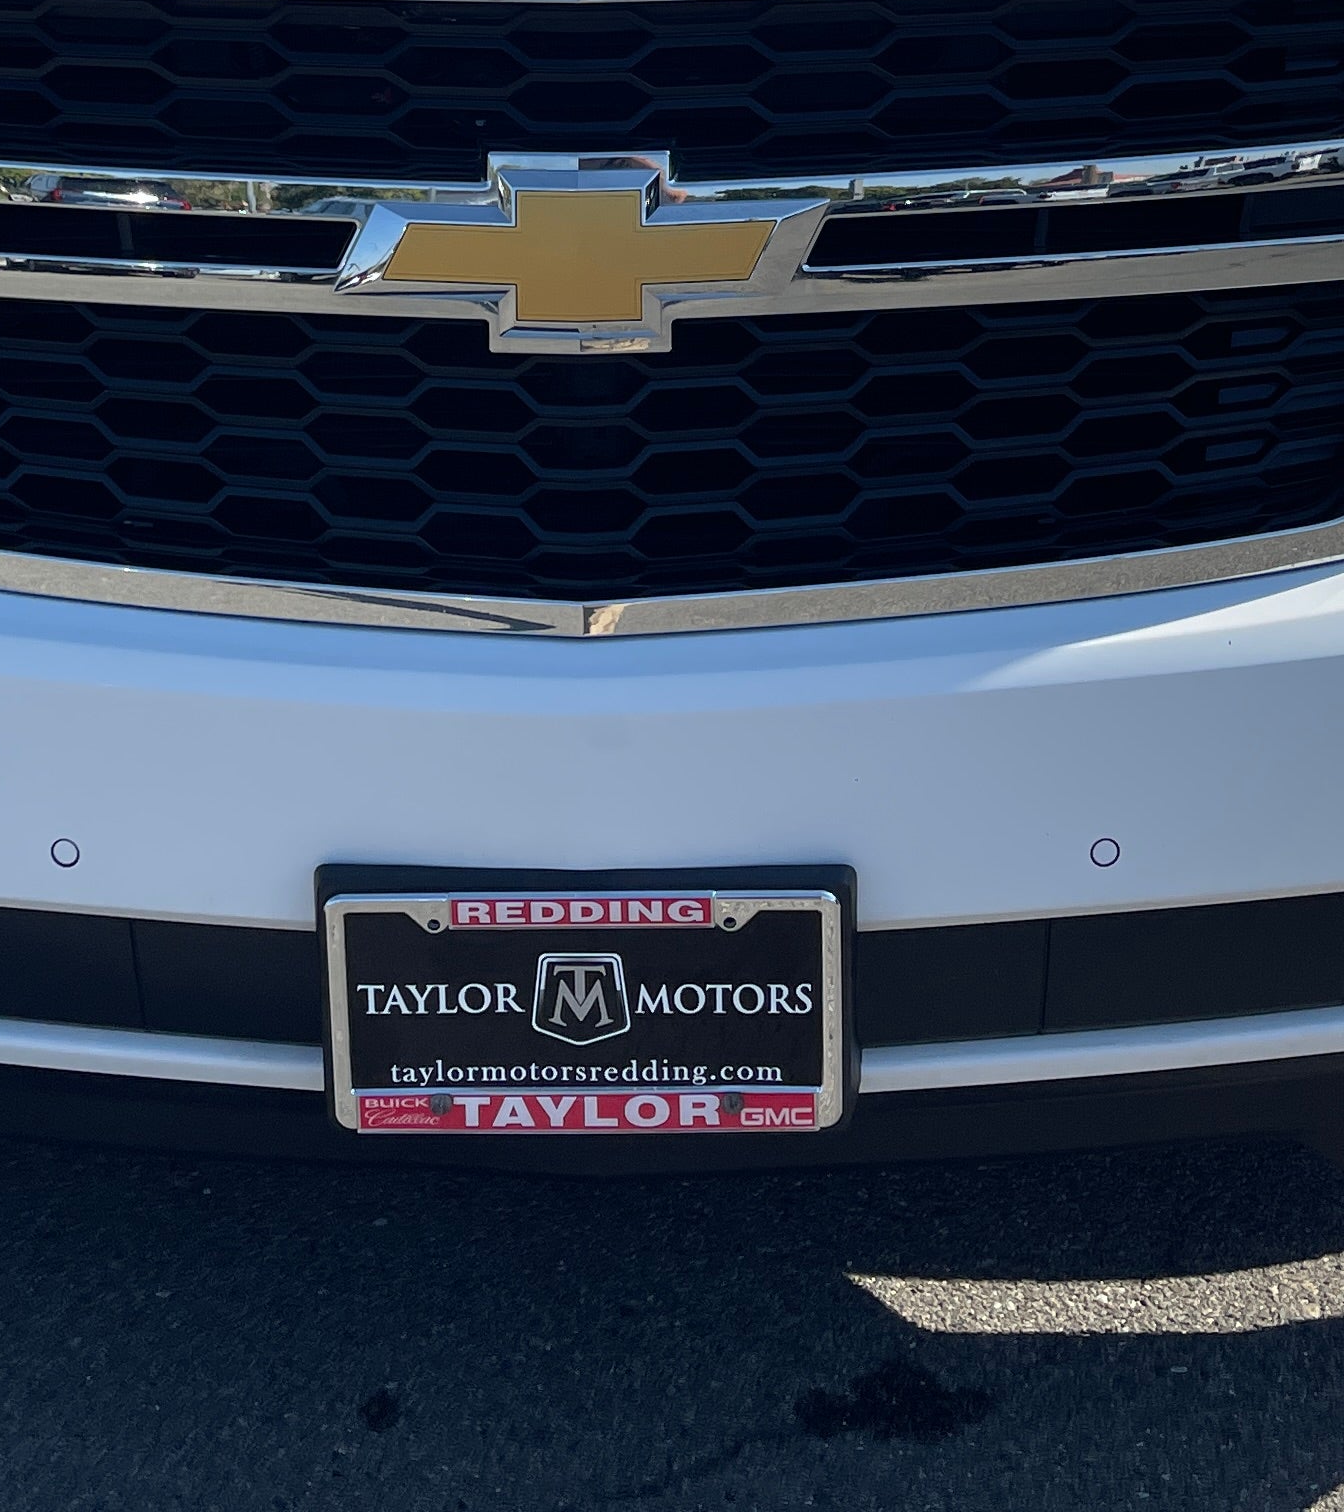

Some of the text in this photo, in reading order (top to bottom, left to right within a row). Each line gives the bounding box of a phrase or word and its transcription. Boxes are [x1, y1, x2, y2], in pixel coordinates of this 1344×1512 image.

[457, 899, 706, 925] REDDING
[356, 982, 814, 1016] TAYLOR MOTORS
[389, 1060, 784, 1087] taylormotorsredding.com
[364, 1097, 430, 1109] BUICK
[453, 1093, 722, 1128] TAYLOR
[739, 1106, 816, 1128] GMC
